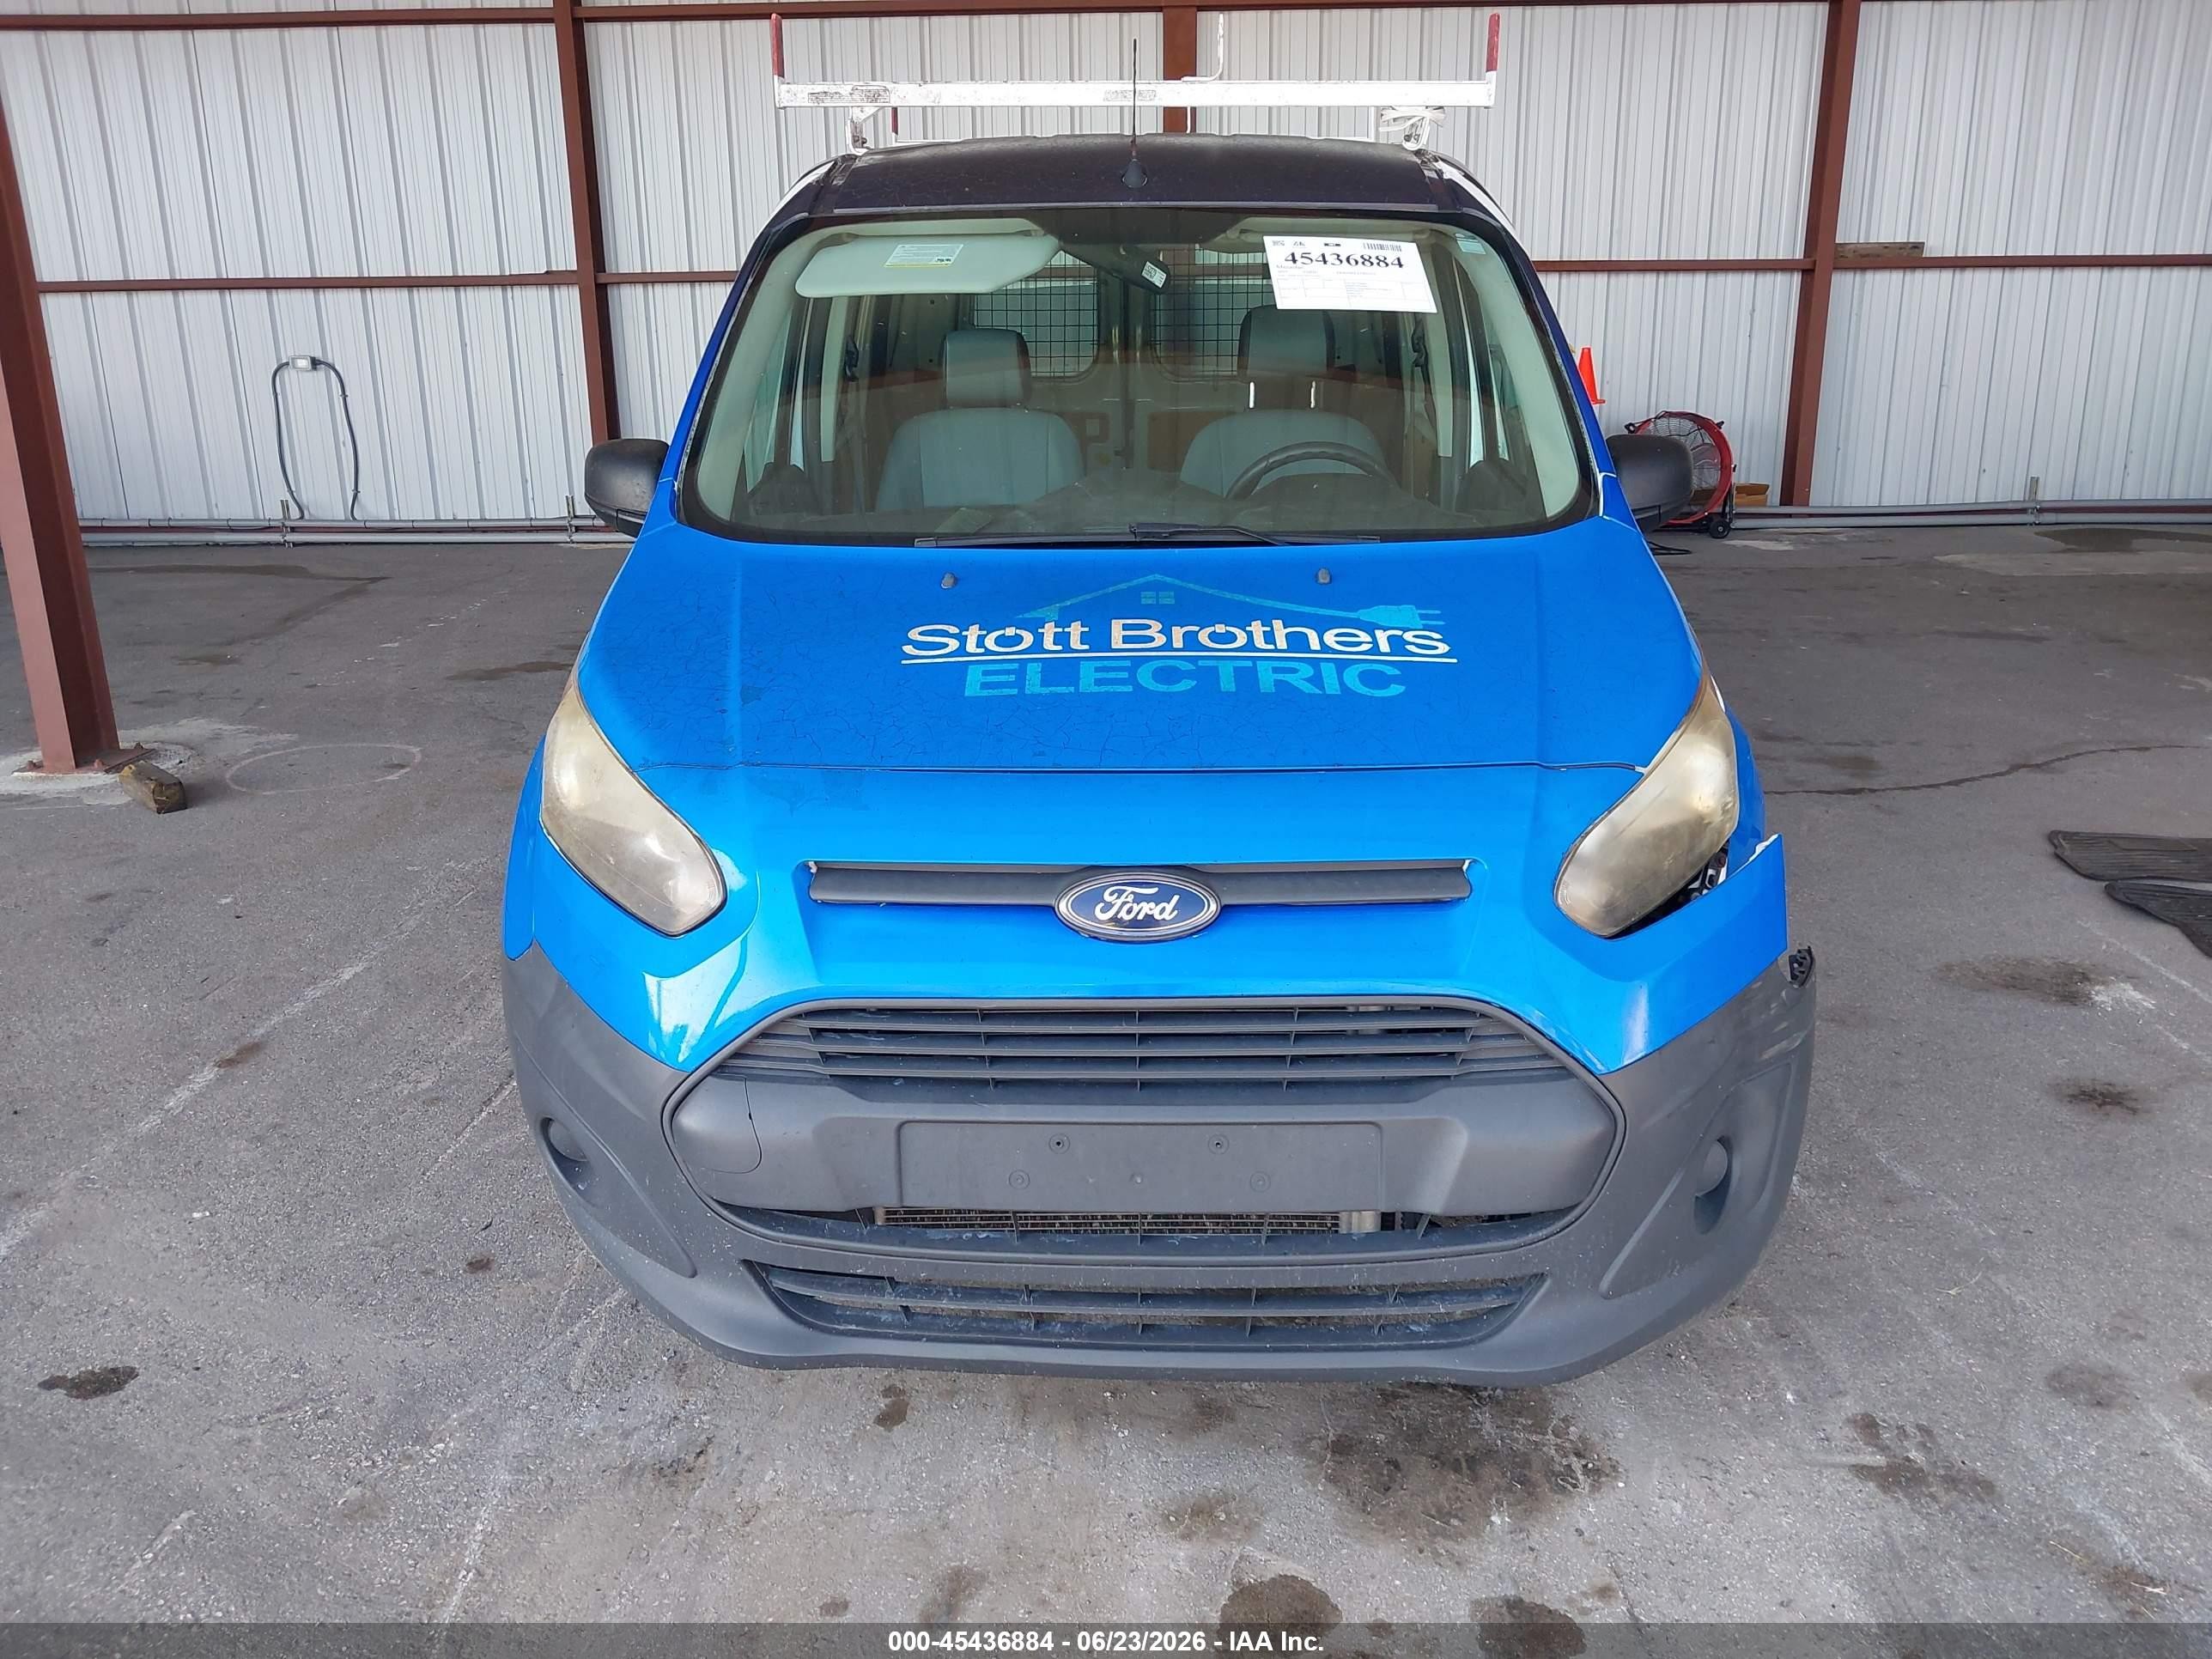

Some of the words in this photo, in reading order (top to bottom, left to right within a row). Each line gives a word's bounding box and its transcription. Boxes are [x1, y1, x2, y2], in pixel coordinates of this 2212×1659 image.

[1284, 252, 1404, 269] 45436884
[901, 620, 1091, 657] Stott
[1109, 618, 1452, 656] Brothers
[963, 659, 1407, 697] ELECTRIC
[1094, 885, 1181, 921] Ford
